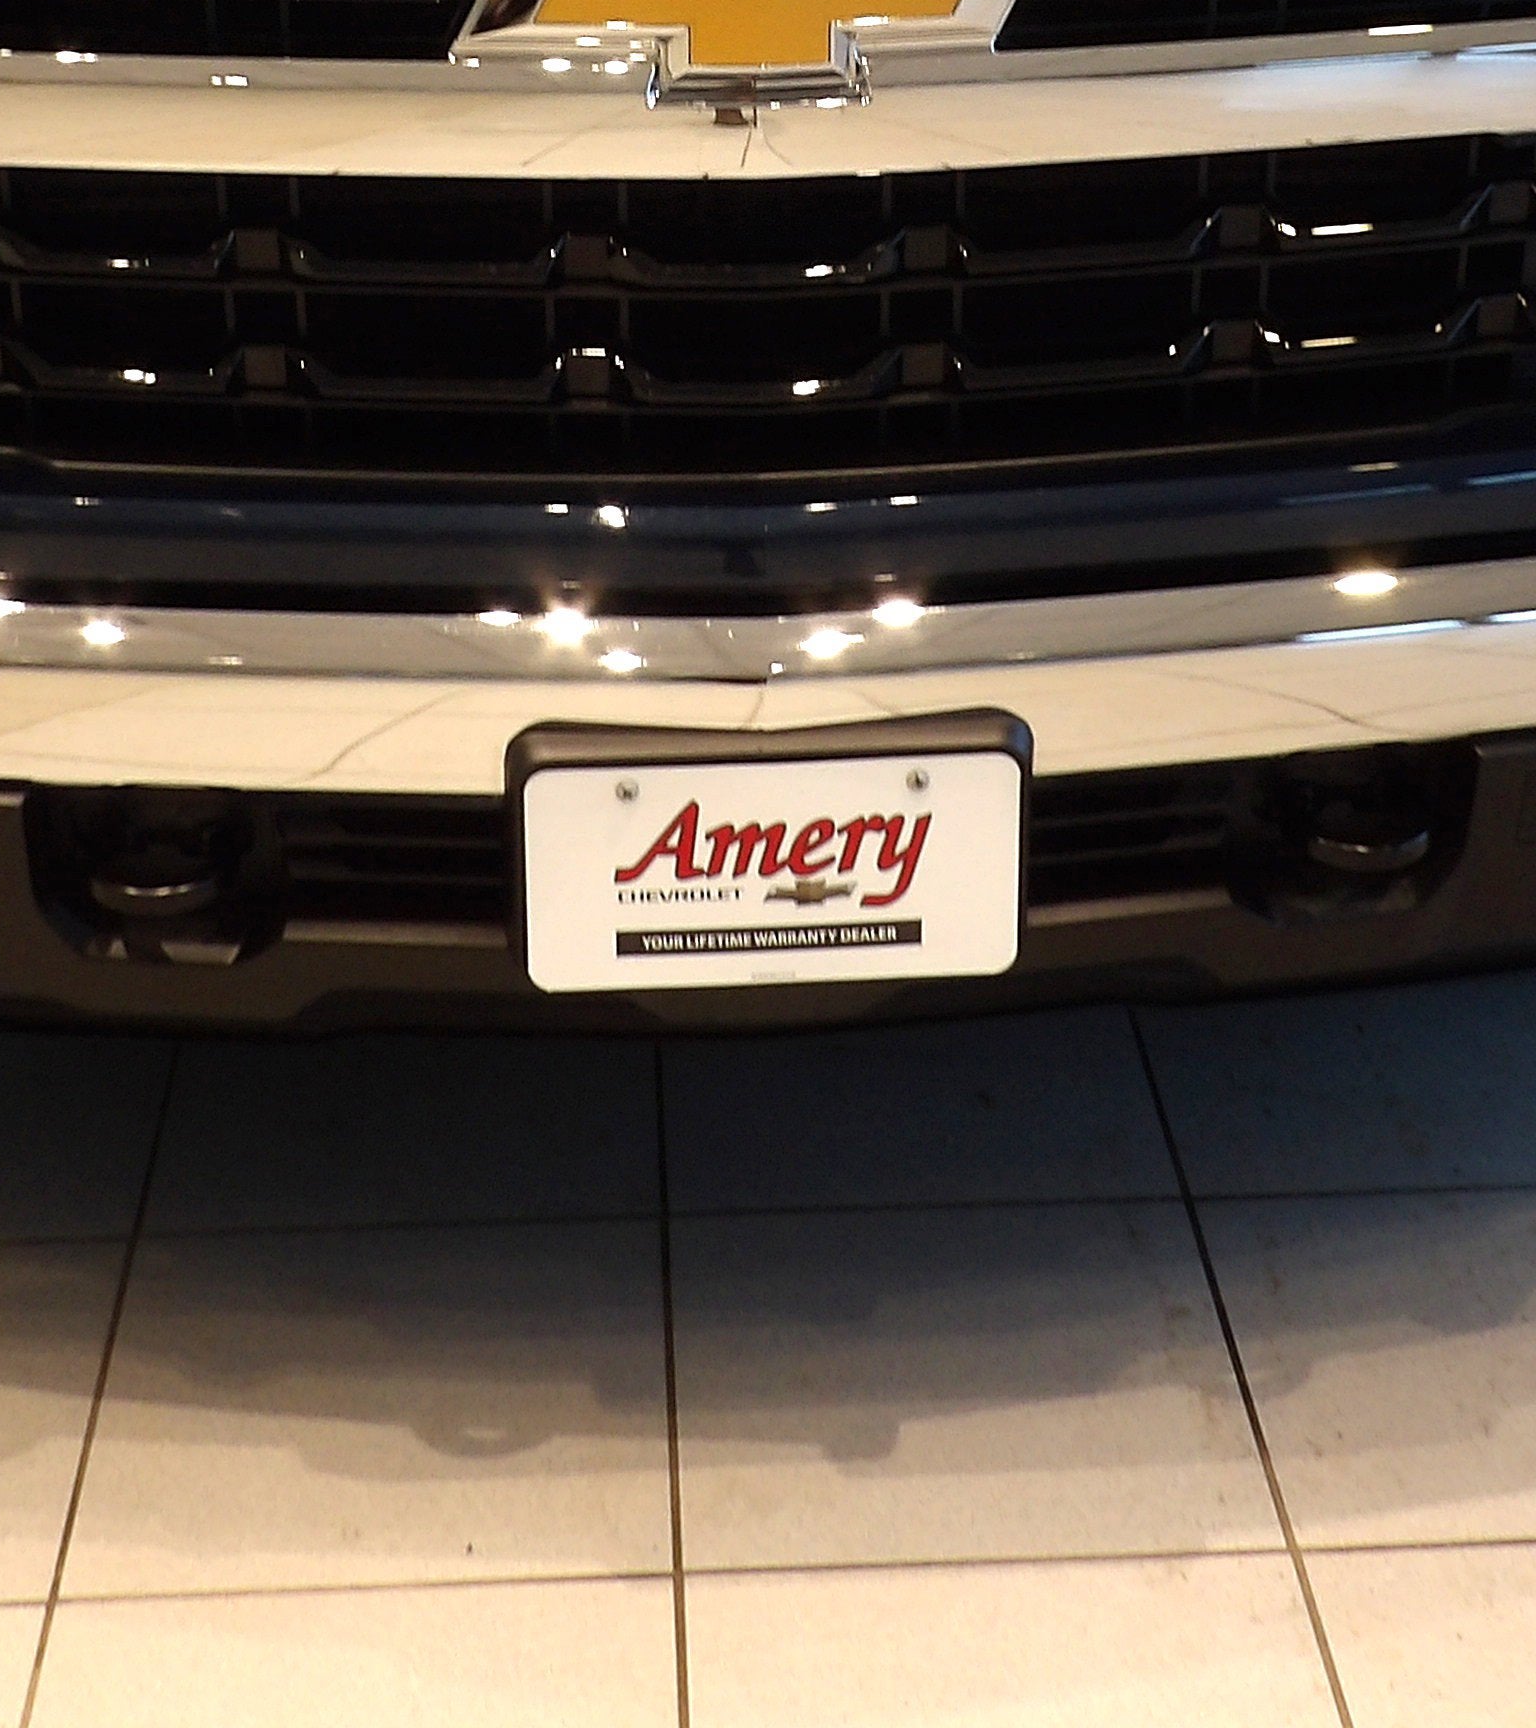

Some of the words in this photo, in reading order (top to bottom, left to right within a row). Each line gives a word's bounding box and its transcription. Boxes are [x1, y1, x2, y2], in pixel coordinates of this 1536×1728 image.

[615, 799, 931, 907] Amery
[618, 887, 744, 904] CHEVROLET
[642, 935, 684, 950] YOUR
[686, 932, 751, 949] LIFETIME
[754, 928, 836, 946] WARRANTY
[840, 925, 897, 943] DEALER
